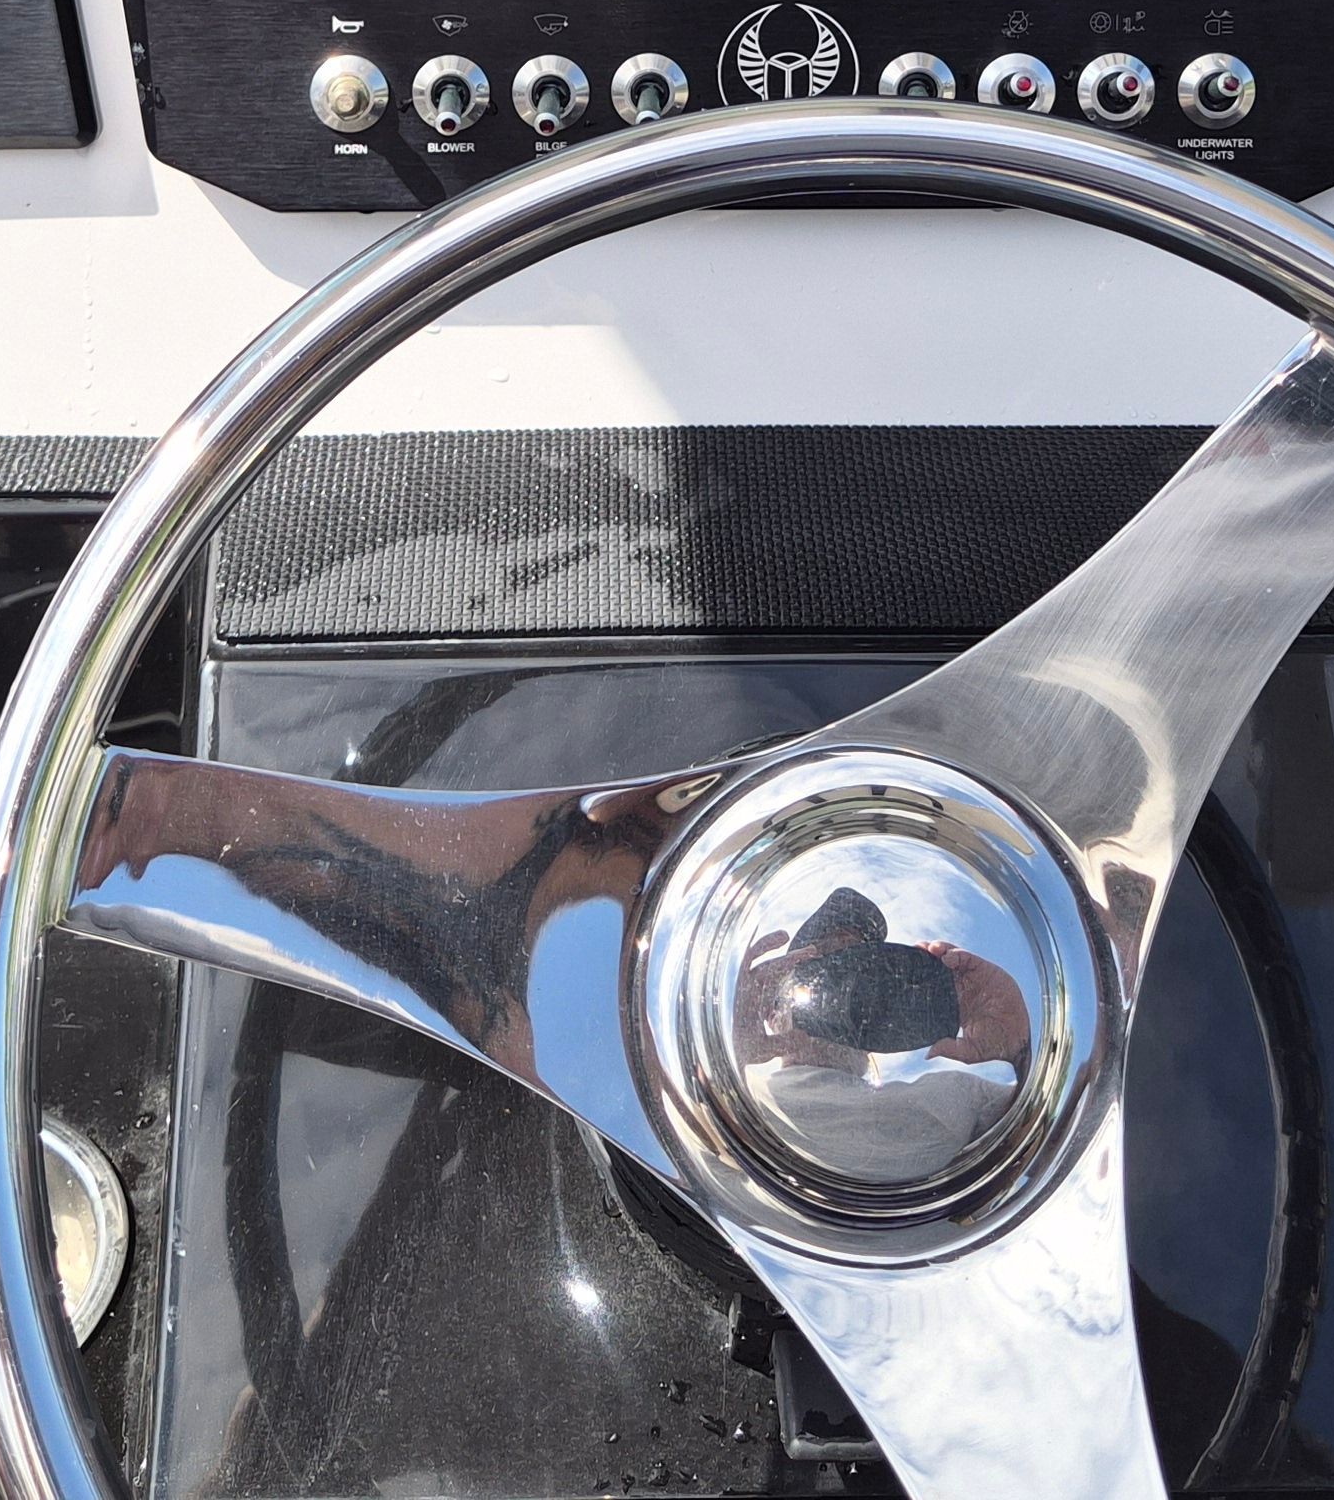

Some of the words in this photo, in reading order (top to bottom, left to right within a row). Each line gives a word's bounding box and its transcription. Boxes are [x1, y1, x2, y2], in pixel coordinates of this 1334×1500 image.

[426, 142, 476, 153] BLOWER
[1177, 138, 1254, 148] UNDERWATER
[333, 144, 368, 154] HORN
[1195, 150, 1235, 160] LIGHTS
